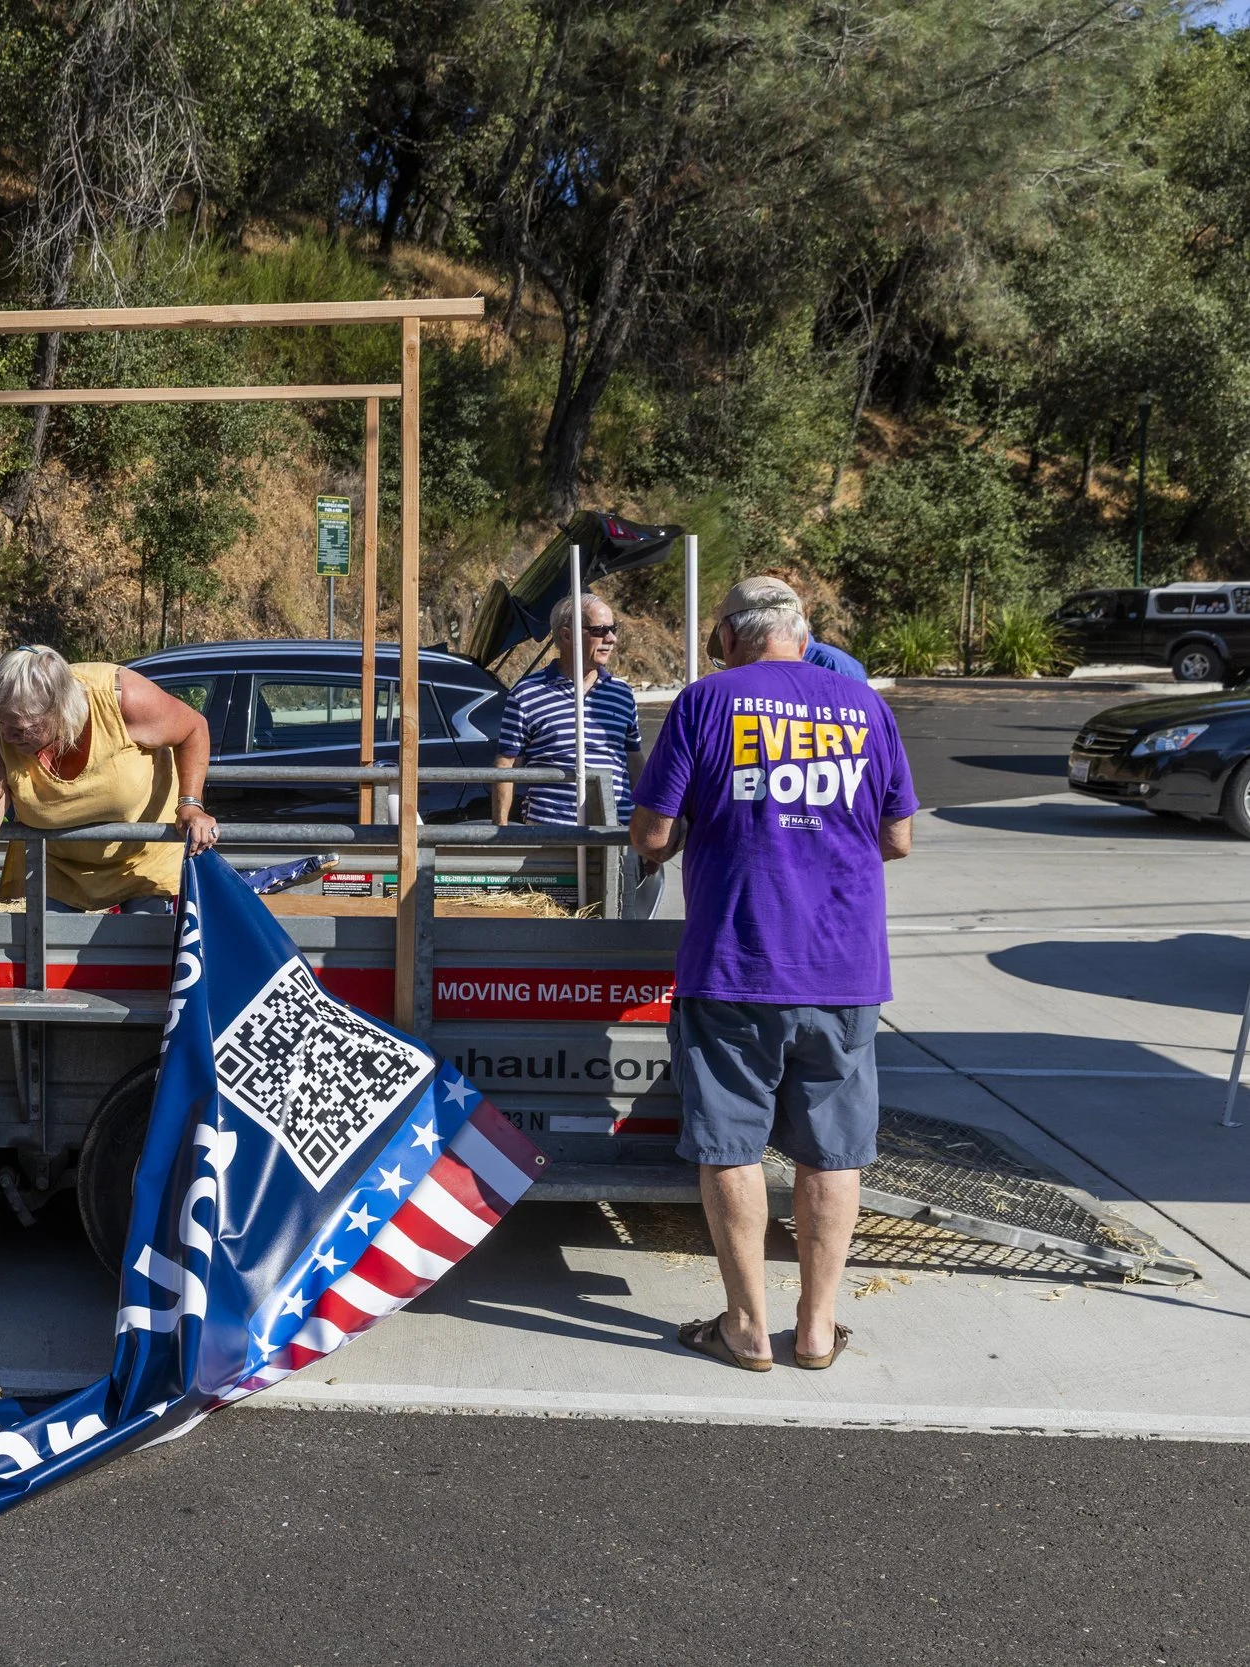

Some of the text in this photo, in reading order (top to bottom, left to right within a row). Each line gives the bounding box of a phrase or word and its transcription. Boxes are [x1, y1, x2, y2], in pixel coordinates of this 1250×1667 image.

[734, 698, 867, 724] FREEDOM IS FOR
[732, 715, 869, 767] EVERY
[733, 758, 869, 814] BODY
[791, 817, 821, 826] NARAL
[512, 876, 558, 884] INSTRUCTIONS
[438, 982, 673, 1004] MOVING MADE EASIE
[530, 1112, 544, 1131] N
